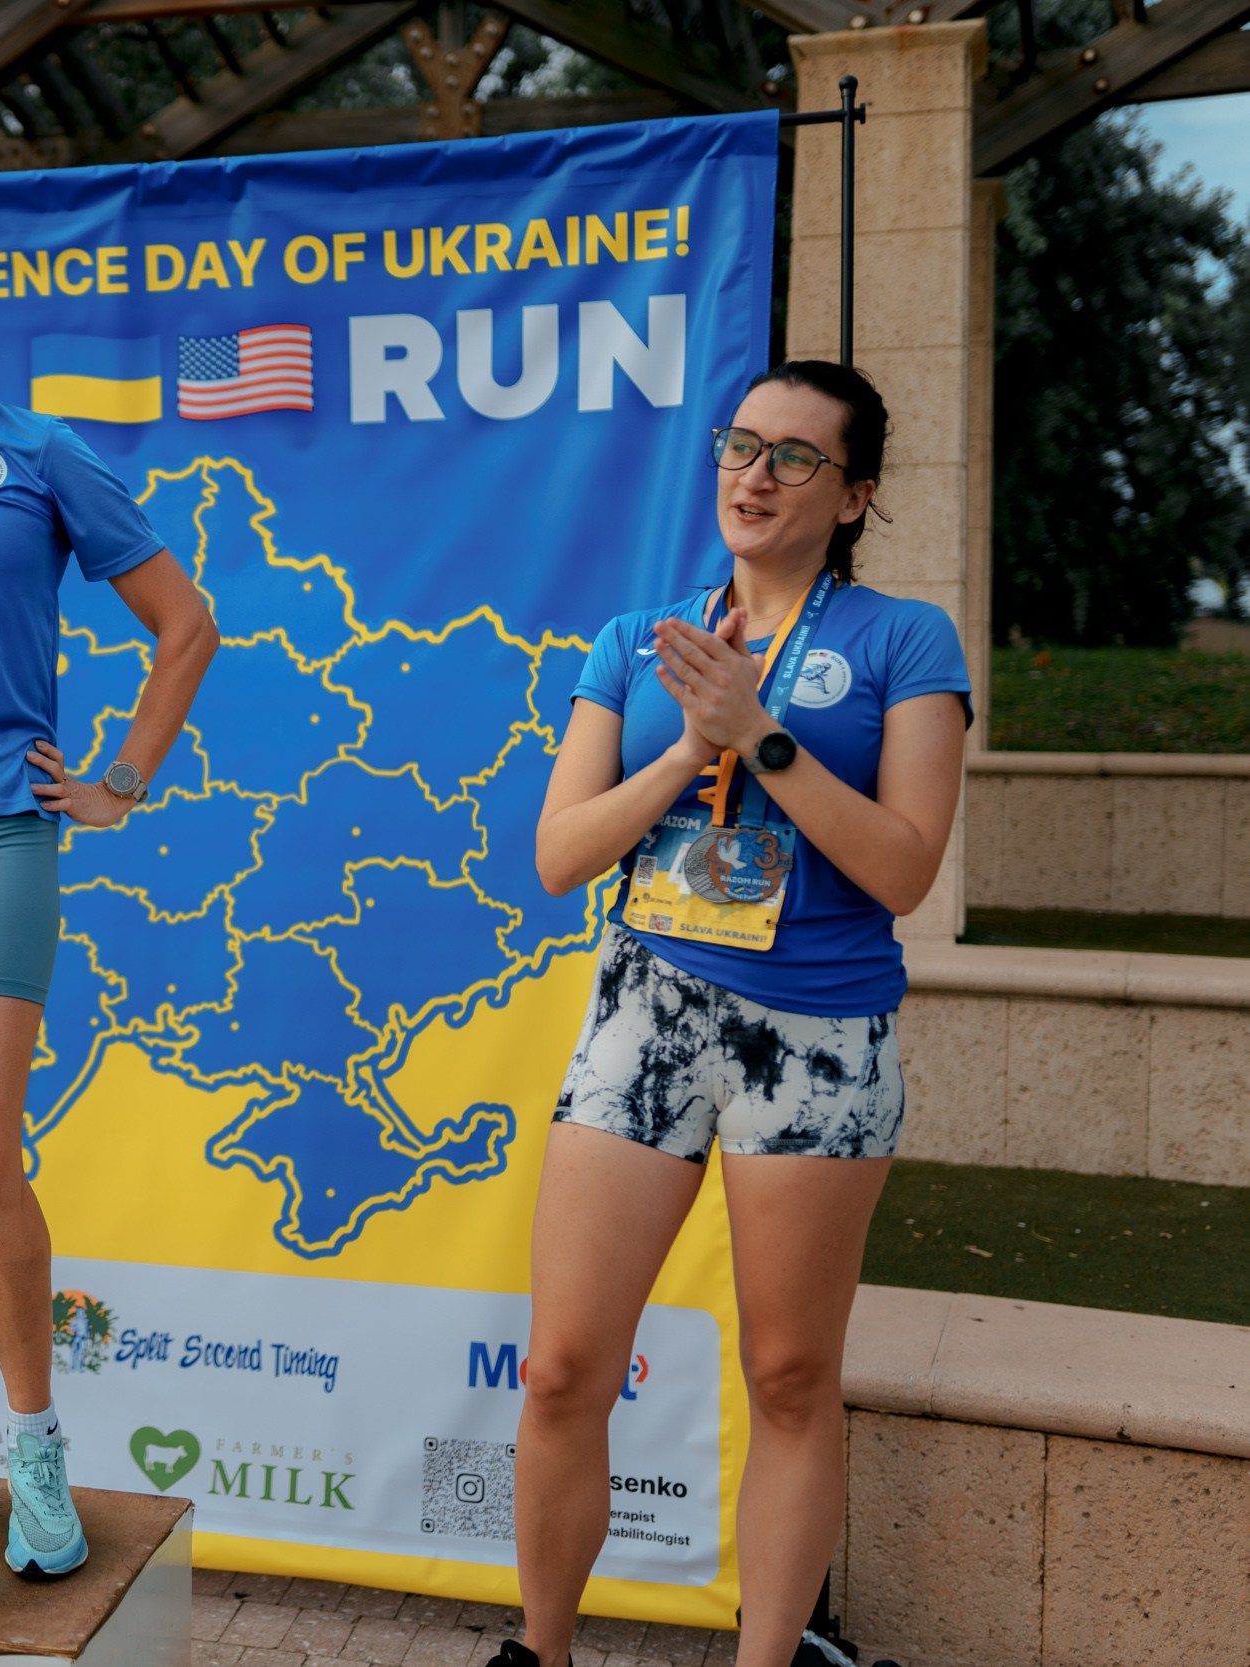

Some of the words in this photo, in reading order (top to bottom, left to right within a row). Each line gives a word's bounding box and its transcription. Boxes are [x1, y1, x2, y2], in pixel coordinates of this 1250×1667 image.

[145, 238, 267, 292] DAY
[283, 232, 366, 285] OF
[383, 205, 690, 279] UKRAINE!
[349, 294, 687, 424] RUN
[782, 656, 798, 678] SLAVA
[657, 815, 702, 831] RAZOM
[754, 833, 779, 869] 3
[720, 875, 751, 885] RAZOM
[752, 878, 771, 887] RUN
[680, 923, 713, 936] SLAVA
[716, 929, 768, 944] UKRAINI!
[115, 1329, 174, 1370] Split
[179, 1335, 262, 1372] Second
[271, 1342, 340, 1393] Timing
[216, 1438, 354, 1466] FARMER'S
[207, 1459, 356, 1510] MILK
[609, 1475, 688, 1498] senko
[609, 1510, 655, 1523] erapist
